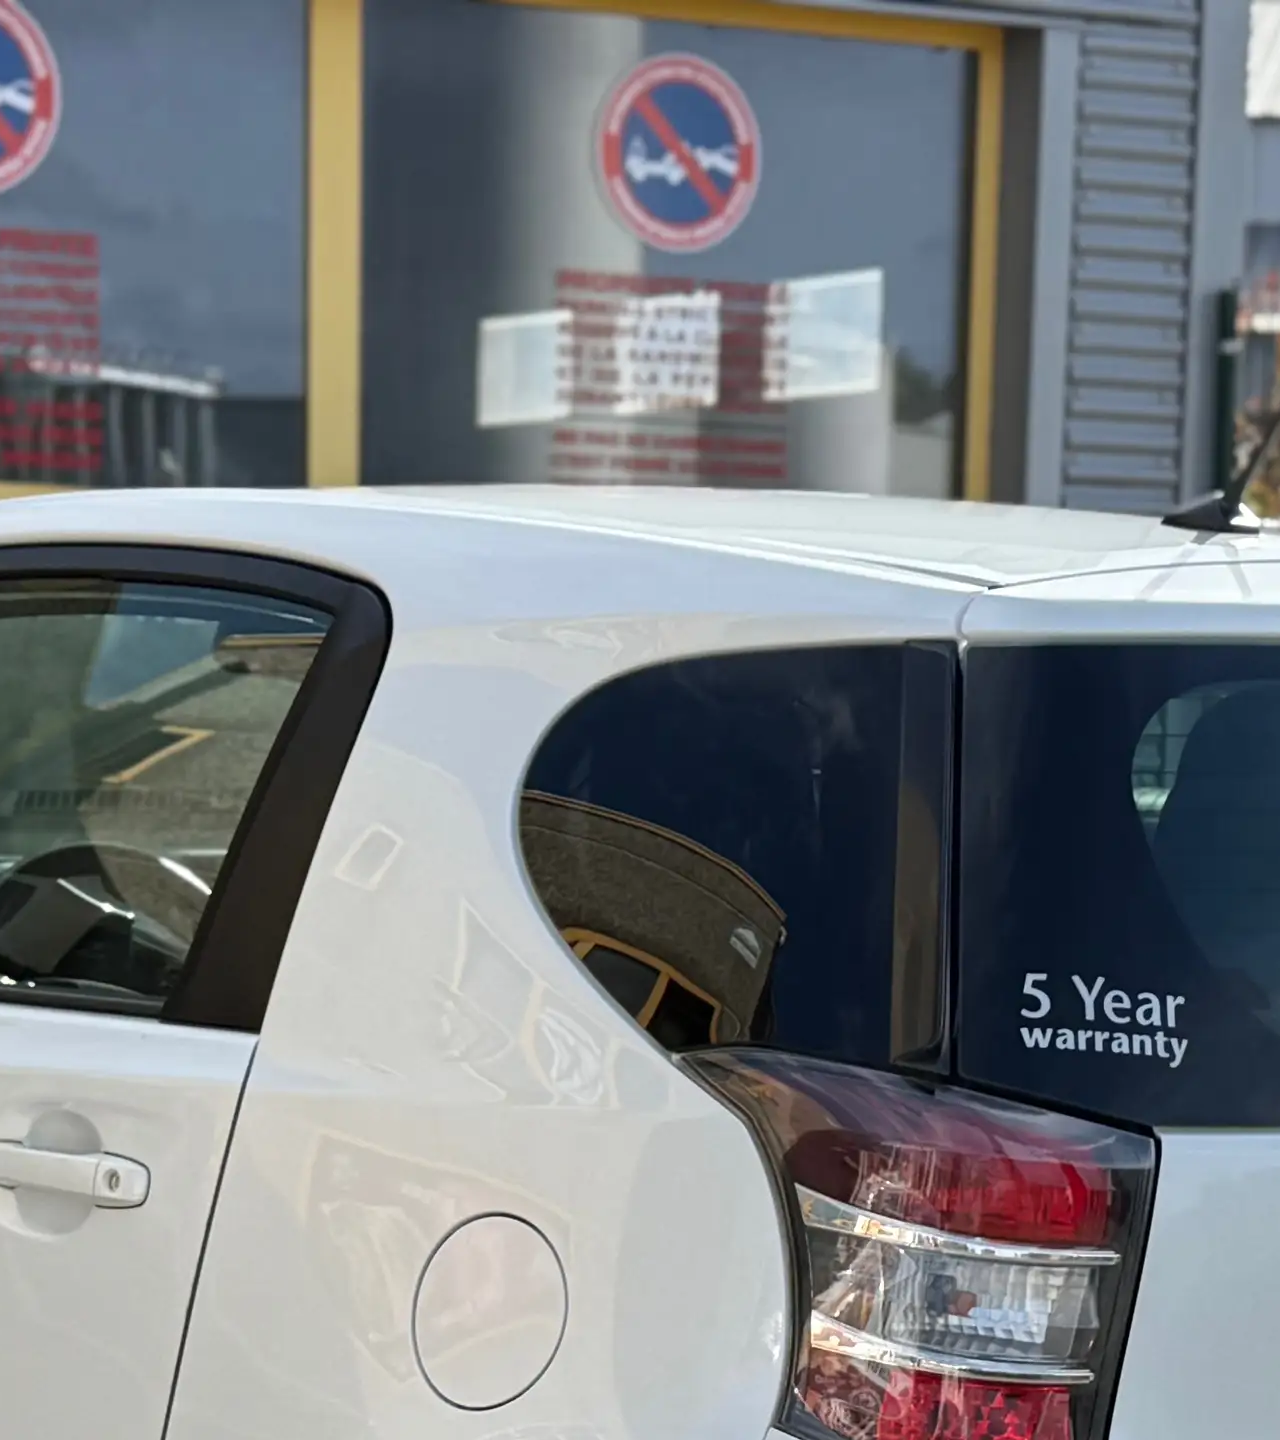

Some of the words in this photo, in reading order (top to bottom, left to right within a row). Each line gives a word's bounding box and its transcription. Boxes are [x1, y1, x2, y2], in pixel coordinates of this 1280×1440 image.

[1020, 972, 1052, 1019] 5
[1071, 974, 1186, 1028] Year
[1020, 1026, 1189, 1069] warranty
